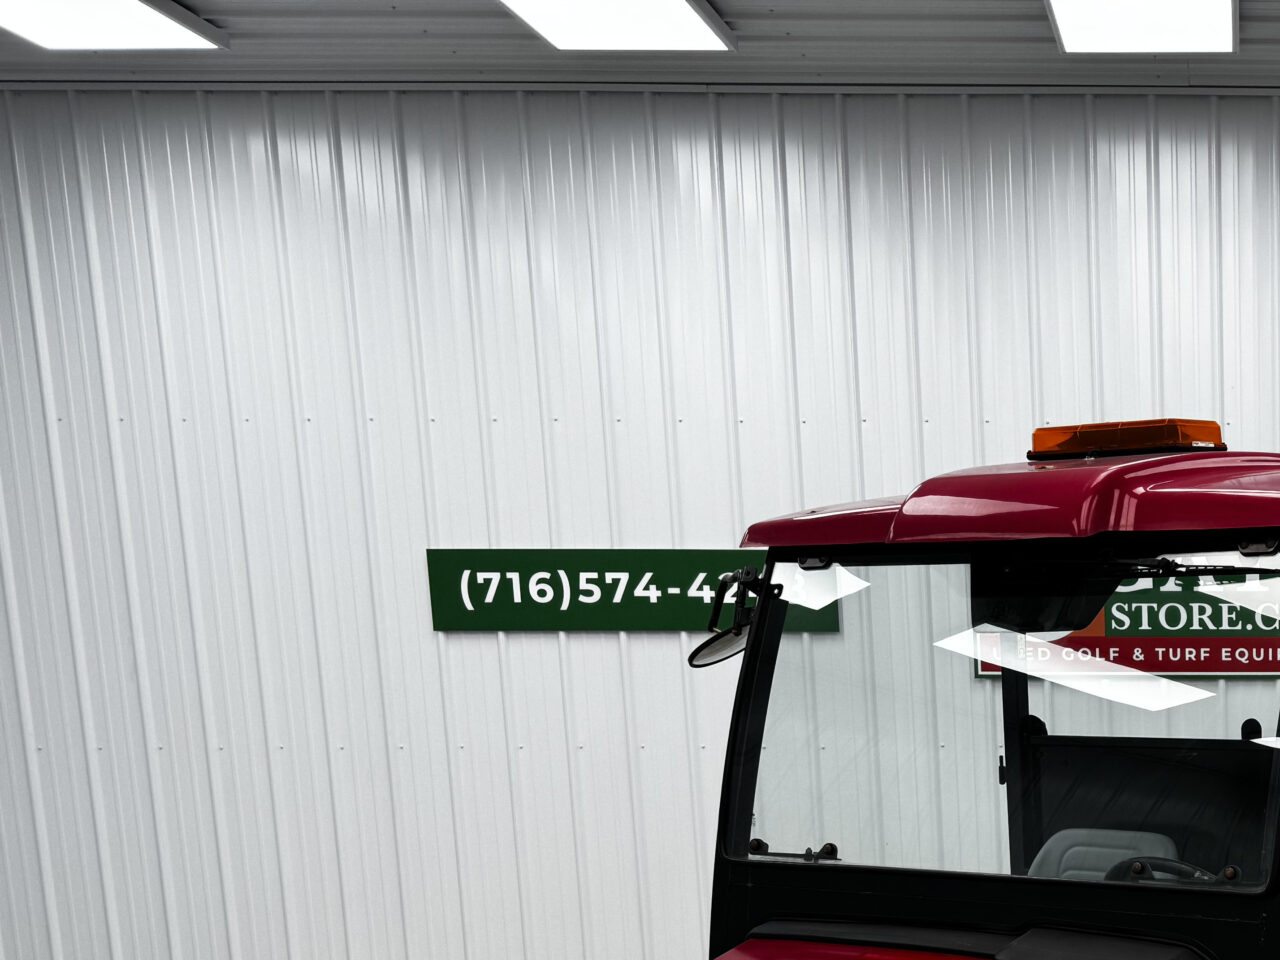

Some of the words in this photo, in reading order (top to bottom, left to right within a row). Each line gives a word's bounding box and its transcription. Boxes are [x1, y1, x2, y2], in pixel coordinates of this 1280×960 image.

[1061, 647, 1120, 662] GOLF
[1132, 647, 1145, 662] &
[1155, 647, 1211, 662] TURF
